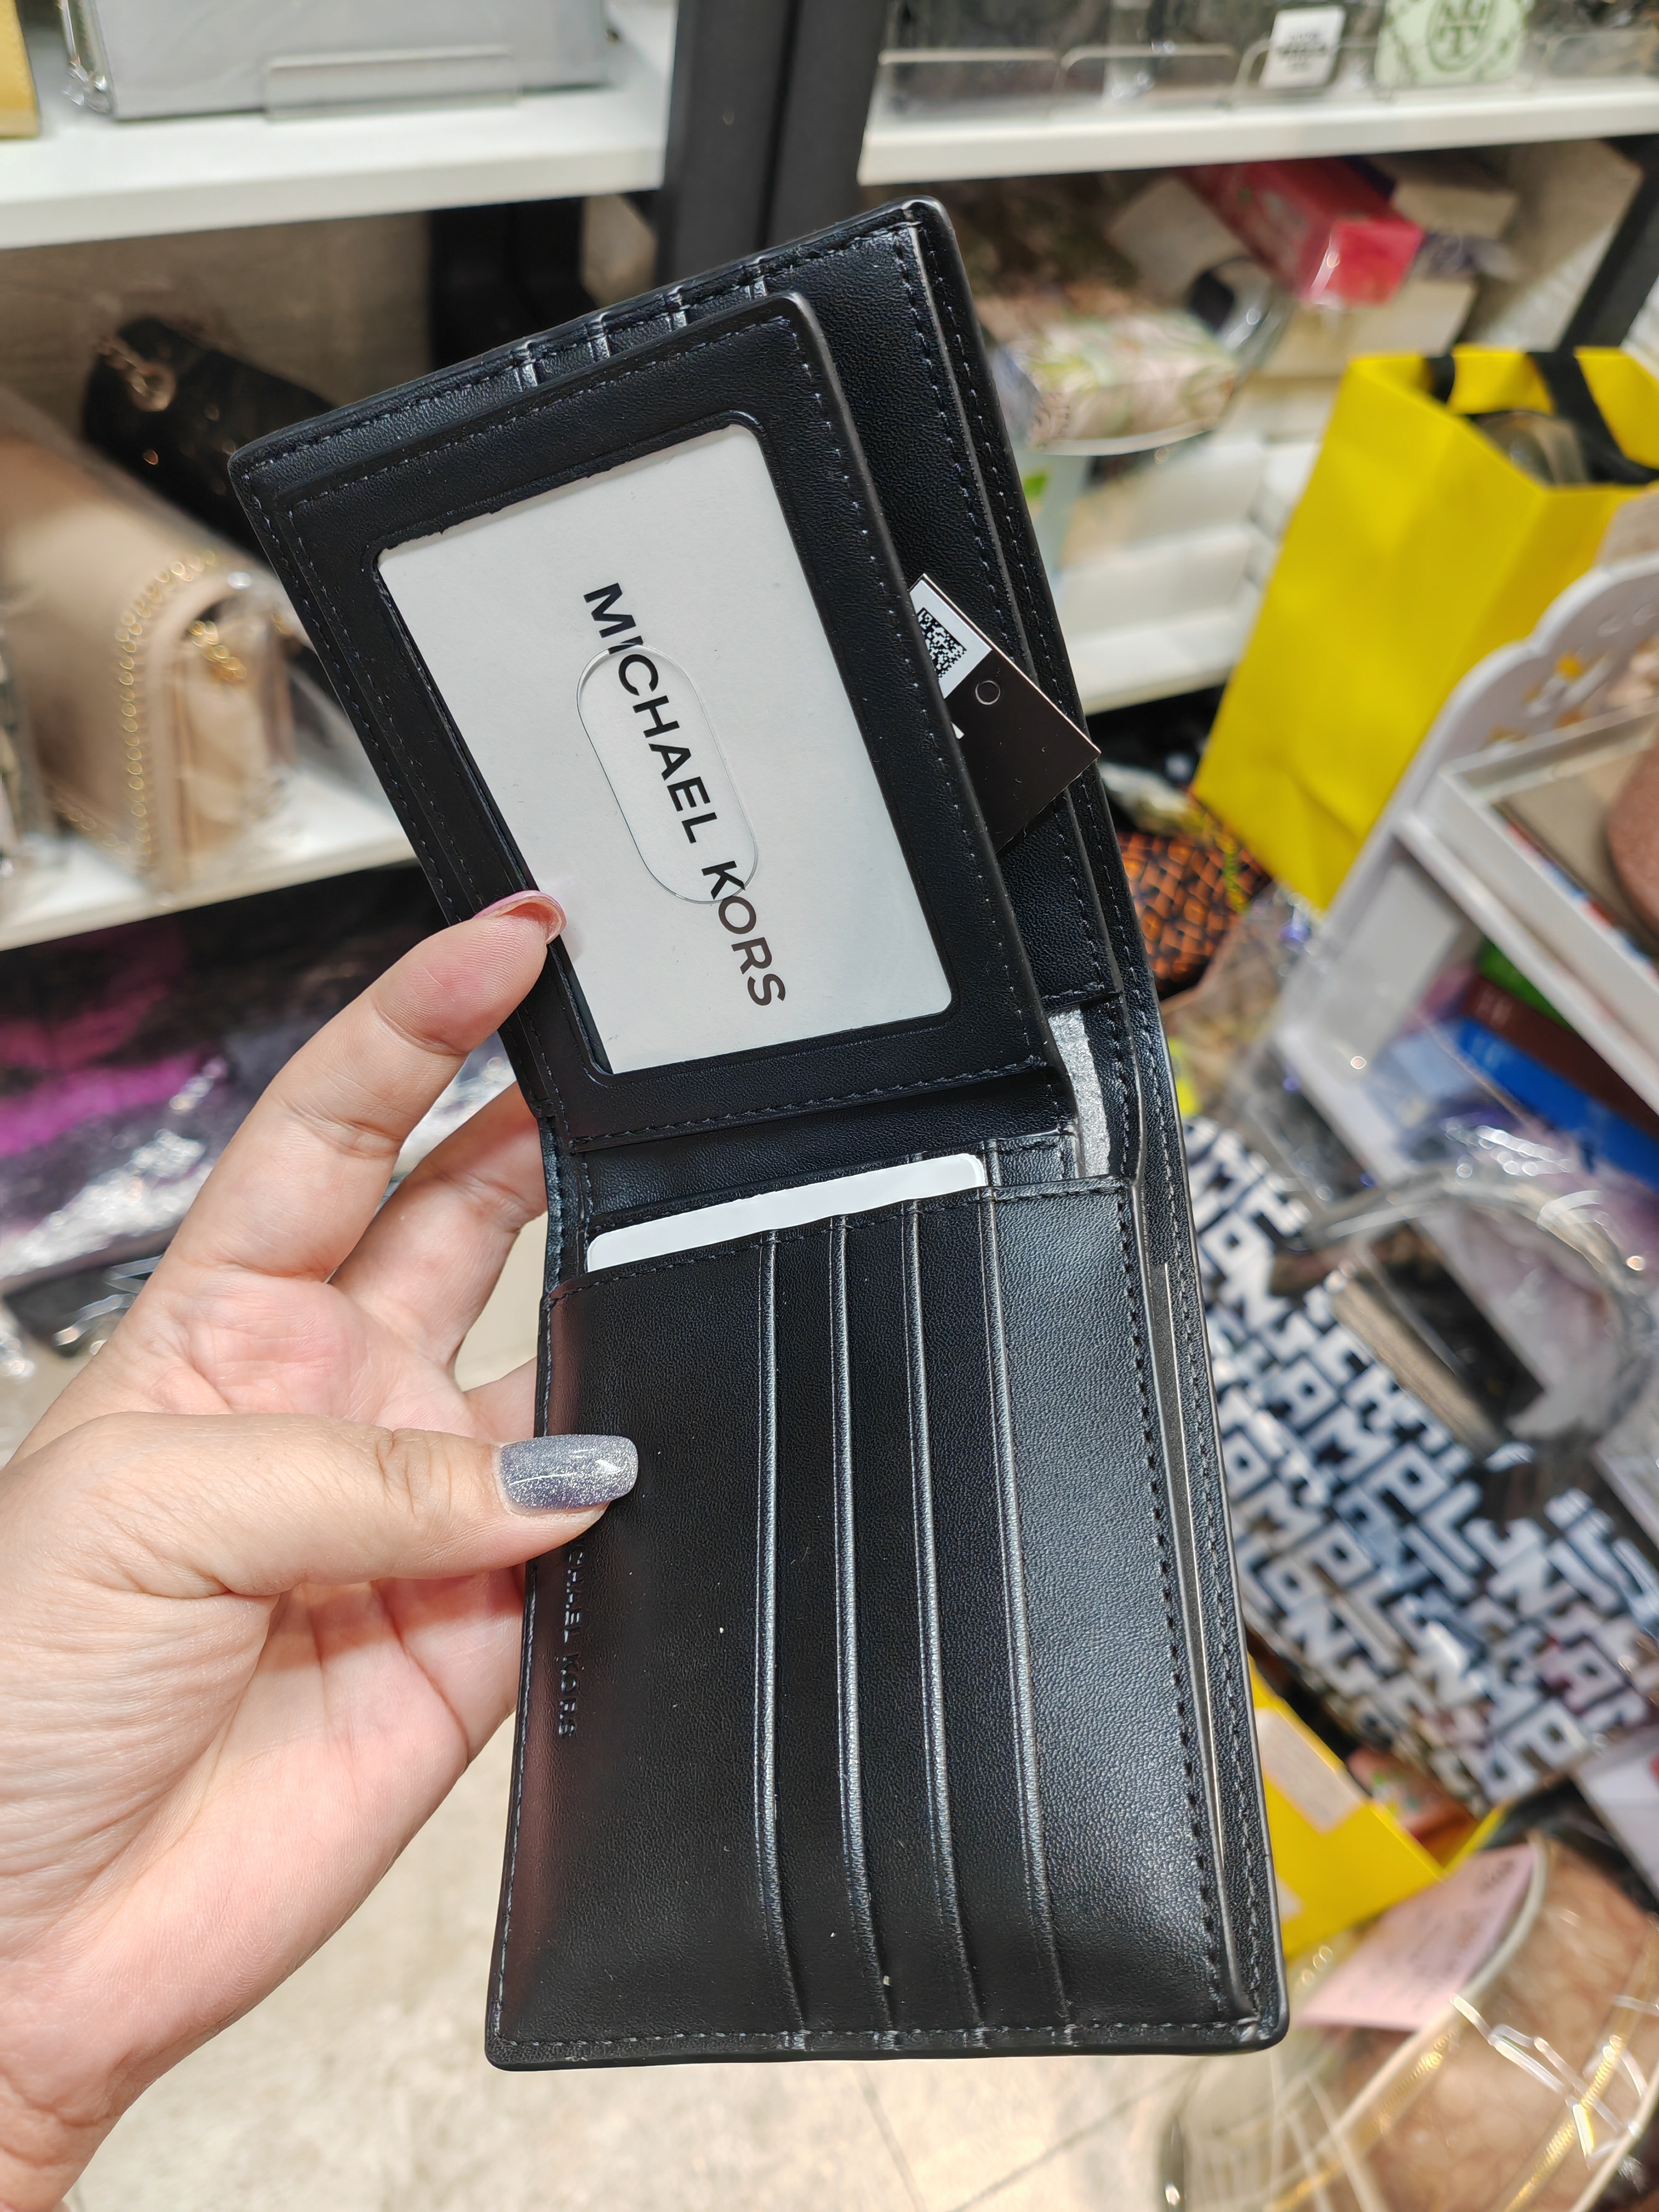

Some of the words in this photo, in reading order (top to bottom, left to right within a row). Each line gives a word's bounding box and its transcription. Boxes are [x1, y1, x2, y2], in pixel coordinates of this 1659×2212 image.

[583, 582, 718, 844] MICHAEL
[701, 860, 786, 1006] KORS
[558, 1654, 579, 1738] KORS
